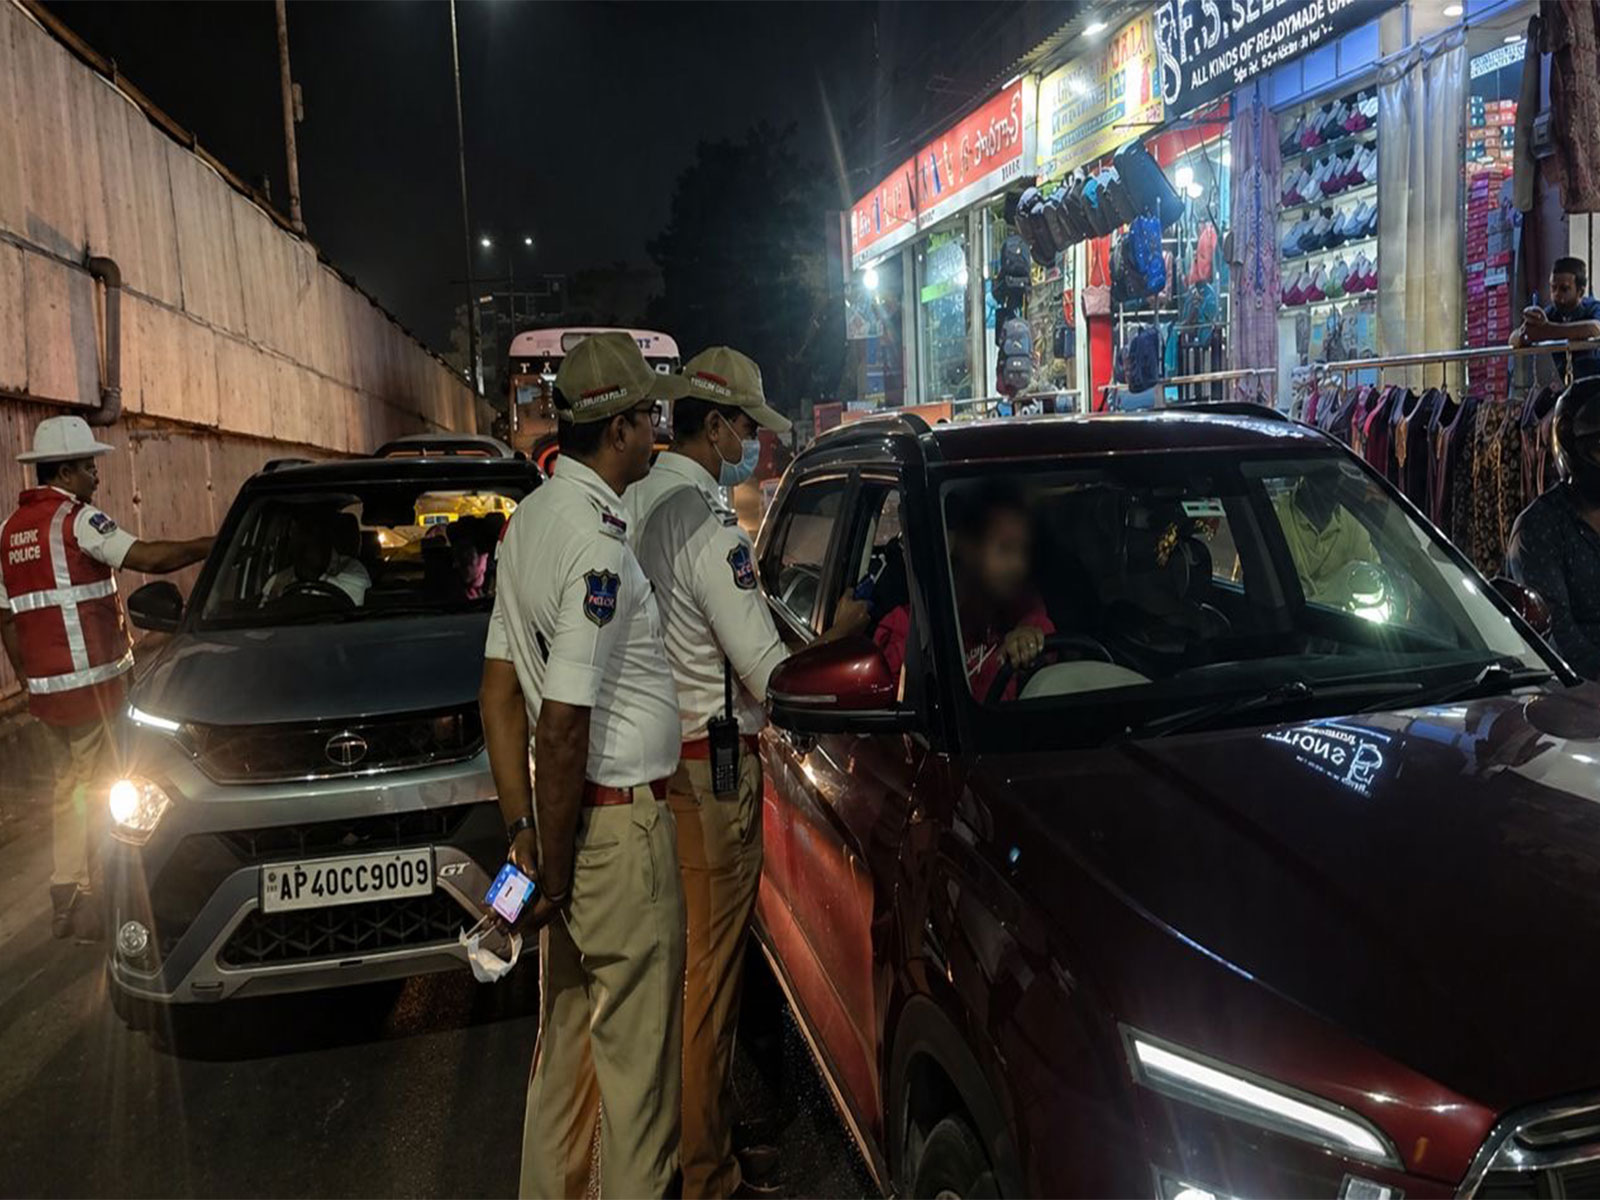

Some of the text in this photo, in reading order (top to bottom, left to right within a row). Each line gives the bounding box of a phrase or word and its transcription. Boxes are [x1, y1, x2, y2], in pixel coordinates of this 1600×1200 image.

[1191, 65, 1209, 90] ALL
[1209, 49, 1239, 81] KINDS
[1239, 37, 1256, 61] OF
[1256, 2, 1325, 54] READYMADE
[9, 545, 41, 565] POLICE
[280, 859, 428, 900] AP40CC9009
[440, 861, 471, 877] GT
